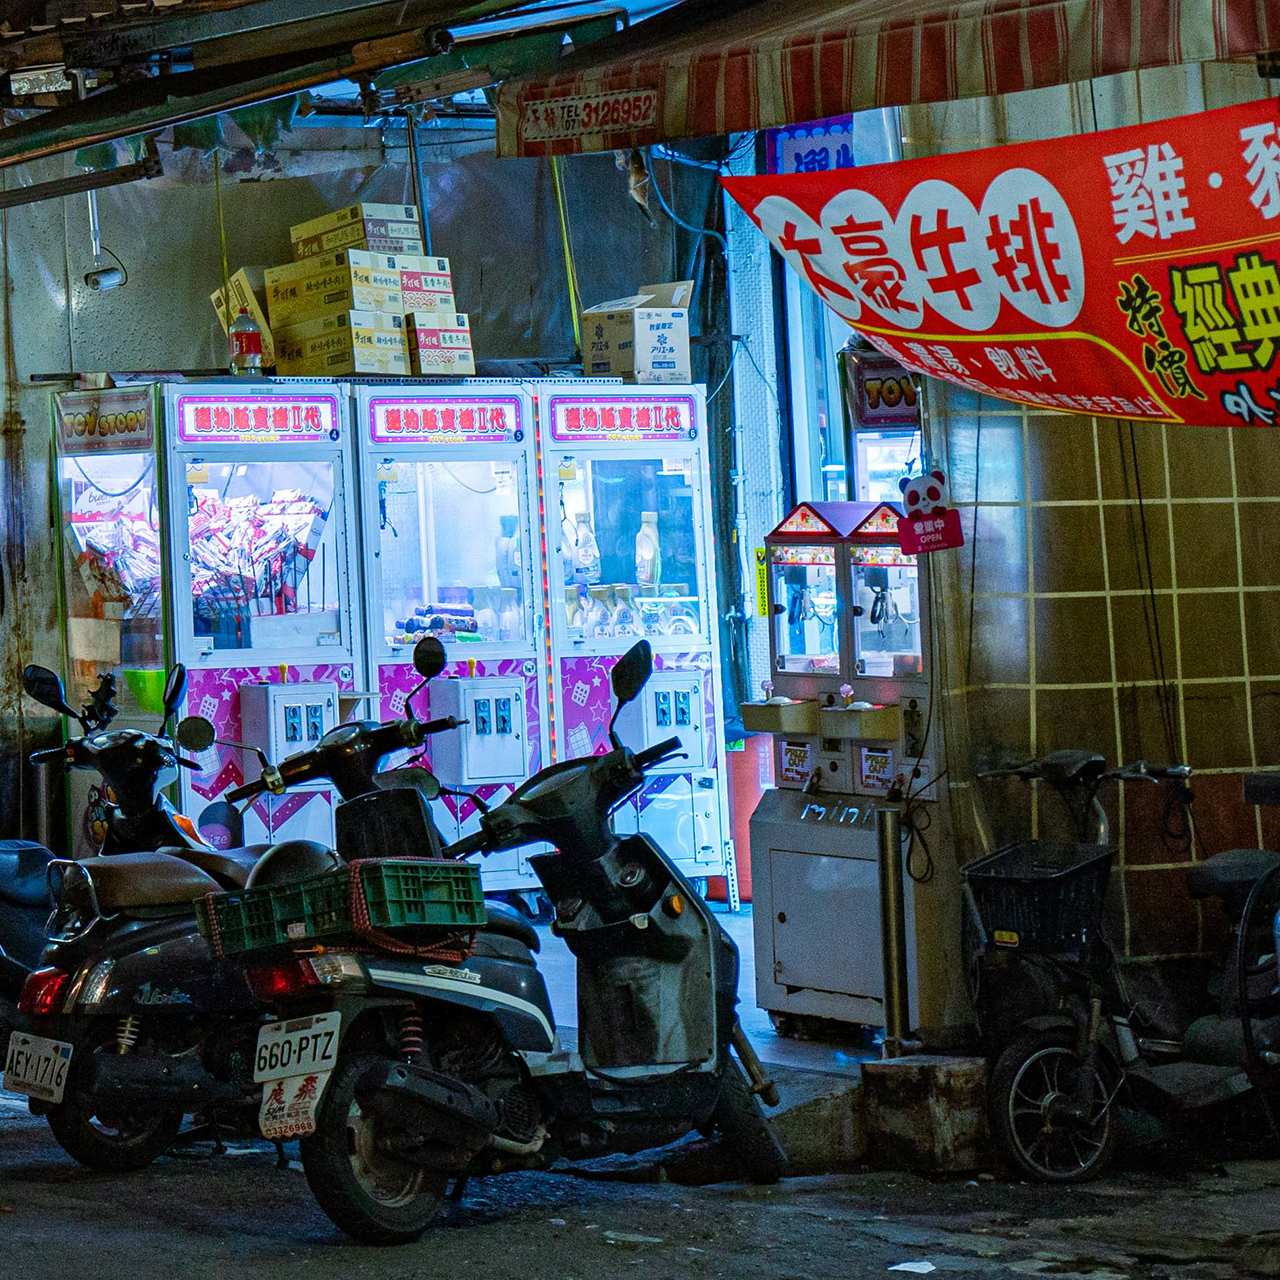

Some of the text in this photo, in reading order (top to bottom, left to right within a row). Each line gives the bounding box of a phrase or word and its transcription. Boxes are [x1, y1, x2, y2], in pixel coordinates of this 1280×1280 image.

[560, 104, 580, 120] TEL
[581, 94, 653, 129] 3126952
[1117, 273, 1207, 402] 特價
[98, 408, 146, 437] STORY
[331, 429, 339, 440] 4
[515, 429, 523, 440] 5
[689, 427, 696, 438] 6
[913, 519, 945, 535] 營業中
[920, 532, 943, 544] OPEN
[272, 1122, 314, 1137] 3326968
